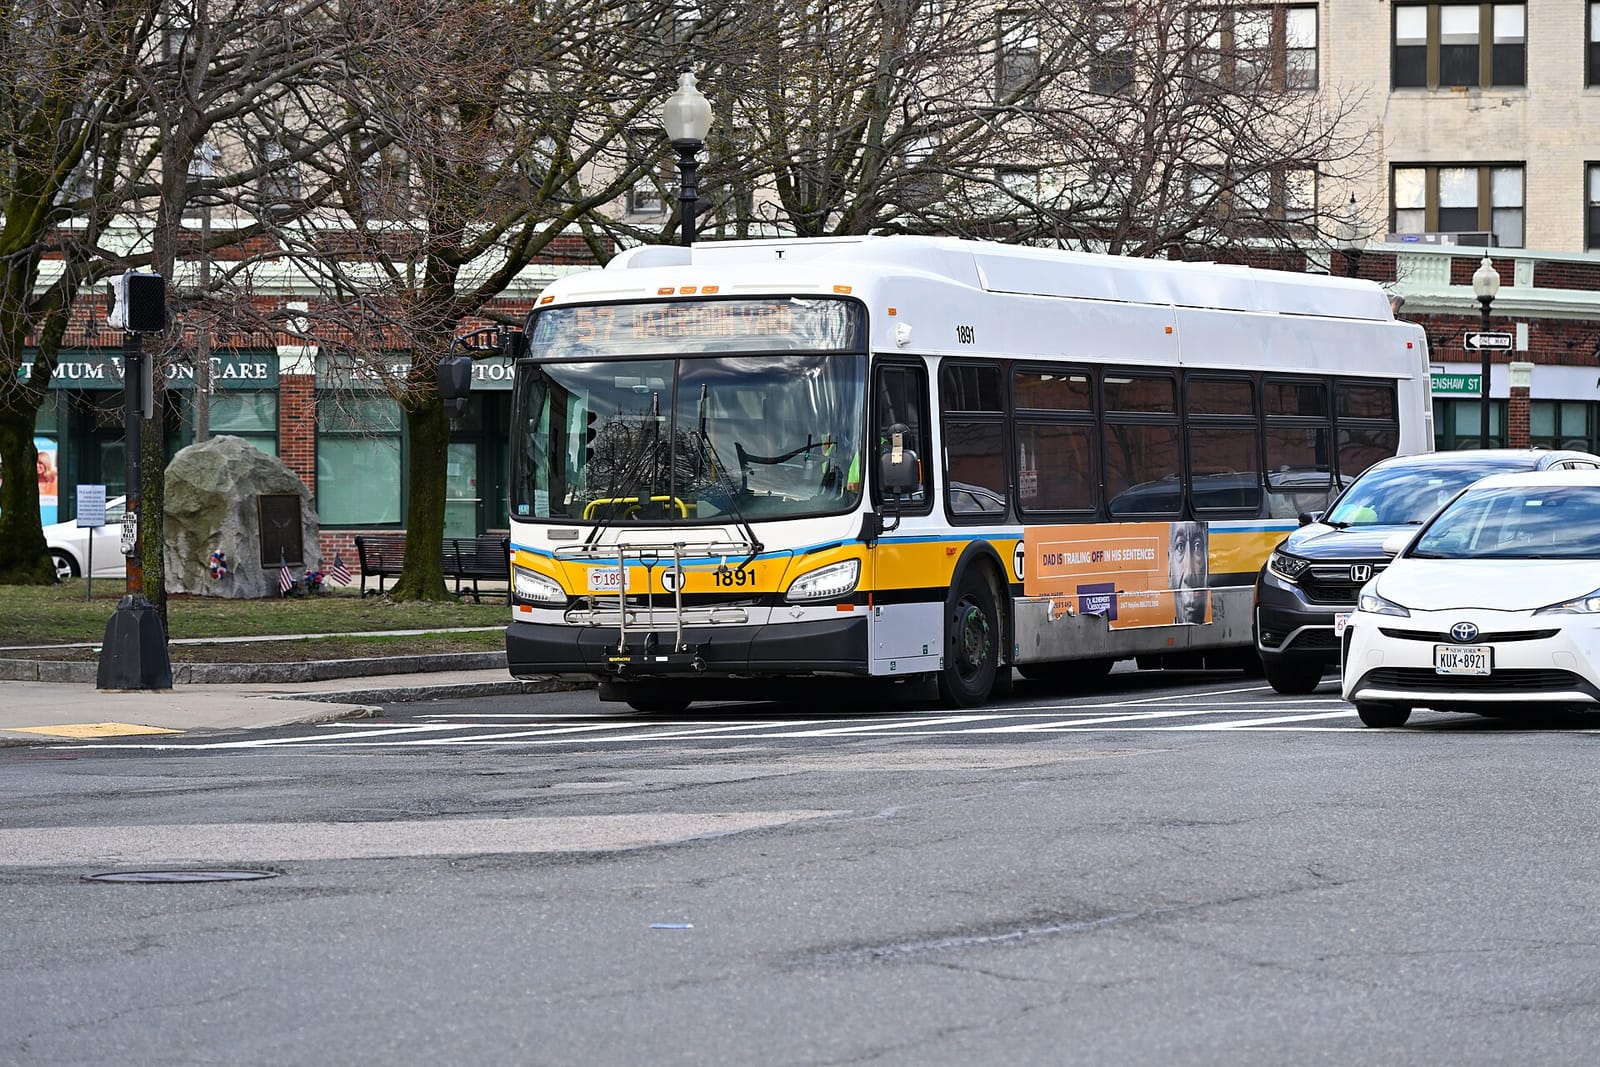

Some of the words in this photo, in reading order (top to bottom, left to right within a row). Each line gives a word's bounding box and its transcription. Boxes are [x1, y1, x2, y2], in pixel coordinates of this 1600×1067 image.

[775, 250, 785, 259] T
[577, 305, 616, 343] 57
[956, 325, 975, 344] 1891
[1495, 338, 1507, 346] WAY
[1432, 378, 1464, 390] ENSHAW
[1468, 378, 1479, 391] ST
[1043, 554, 1056, 566] DAD
[1057, 553, 1063, 565] IS
[1064, 552, 1091, 565] TRAILING
[1091, 551, 1104, 562] OFF
[1104, 550, 1111, 562] IN
[1112, 550, 1122, 561] HIS
[1122, 549, 1155, 560] SENTENCES
[712, 569, 756, 587] 1891
